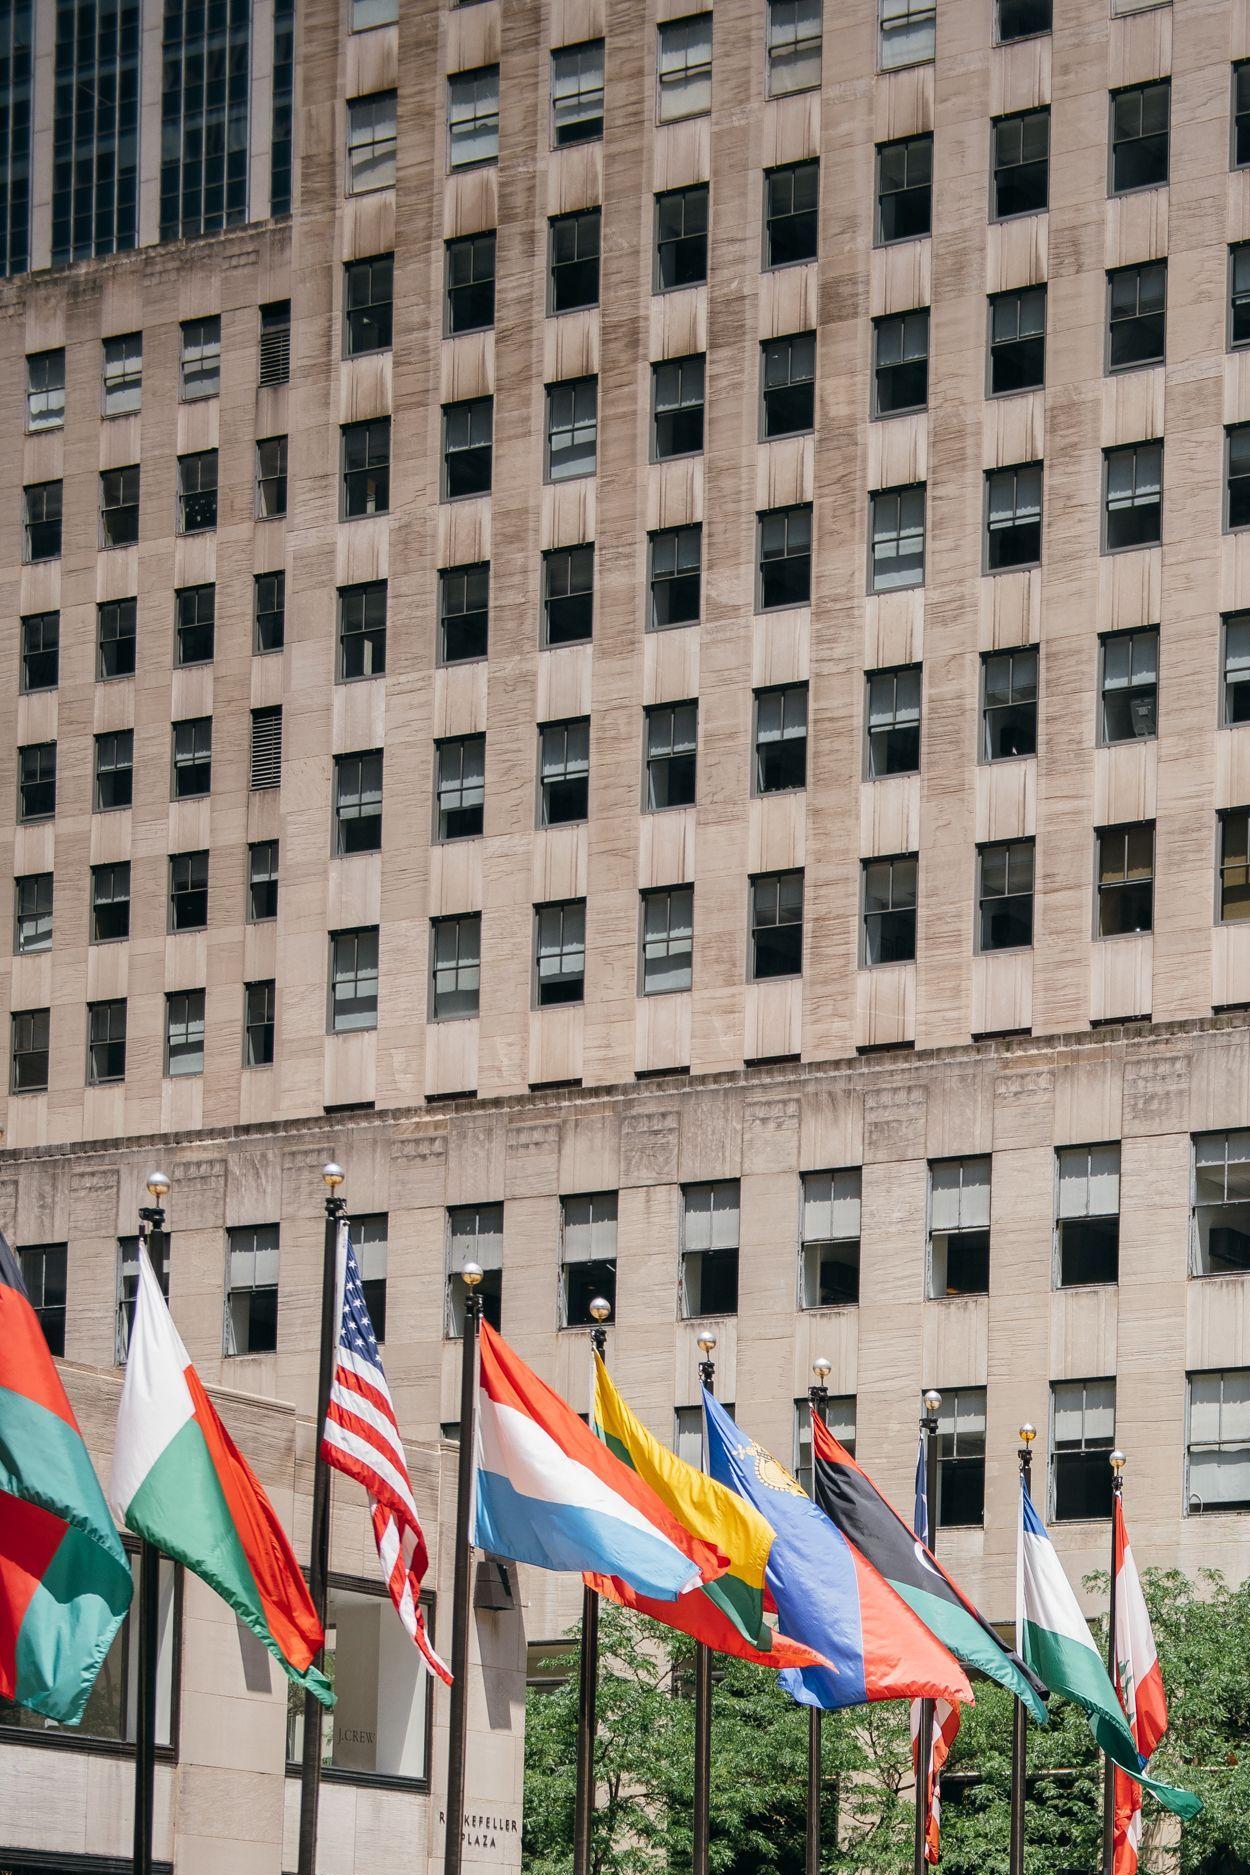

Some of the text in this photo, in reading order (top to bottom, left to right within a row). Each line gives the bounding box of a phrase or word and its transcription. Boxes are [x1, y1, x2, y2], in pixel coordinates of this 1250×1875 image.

[337, 1728, 376, 1744] J.CREW
[439, 1811, 518, 1832] RKEFELLER
[461, 1832, 496, 1849] PLAZA
